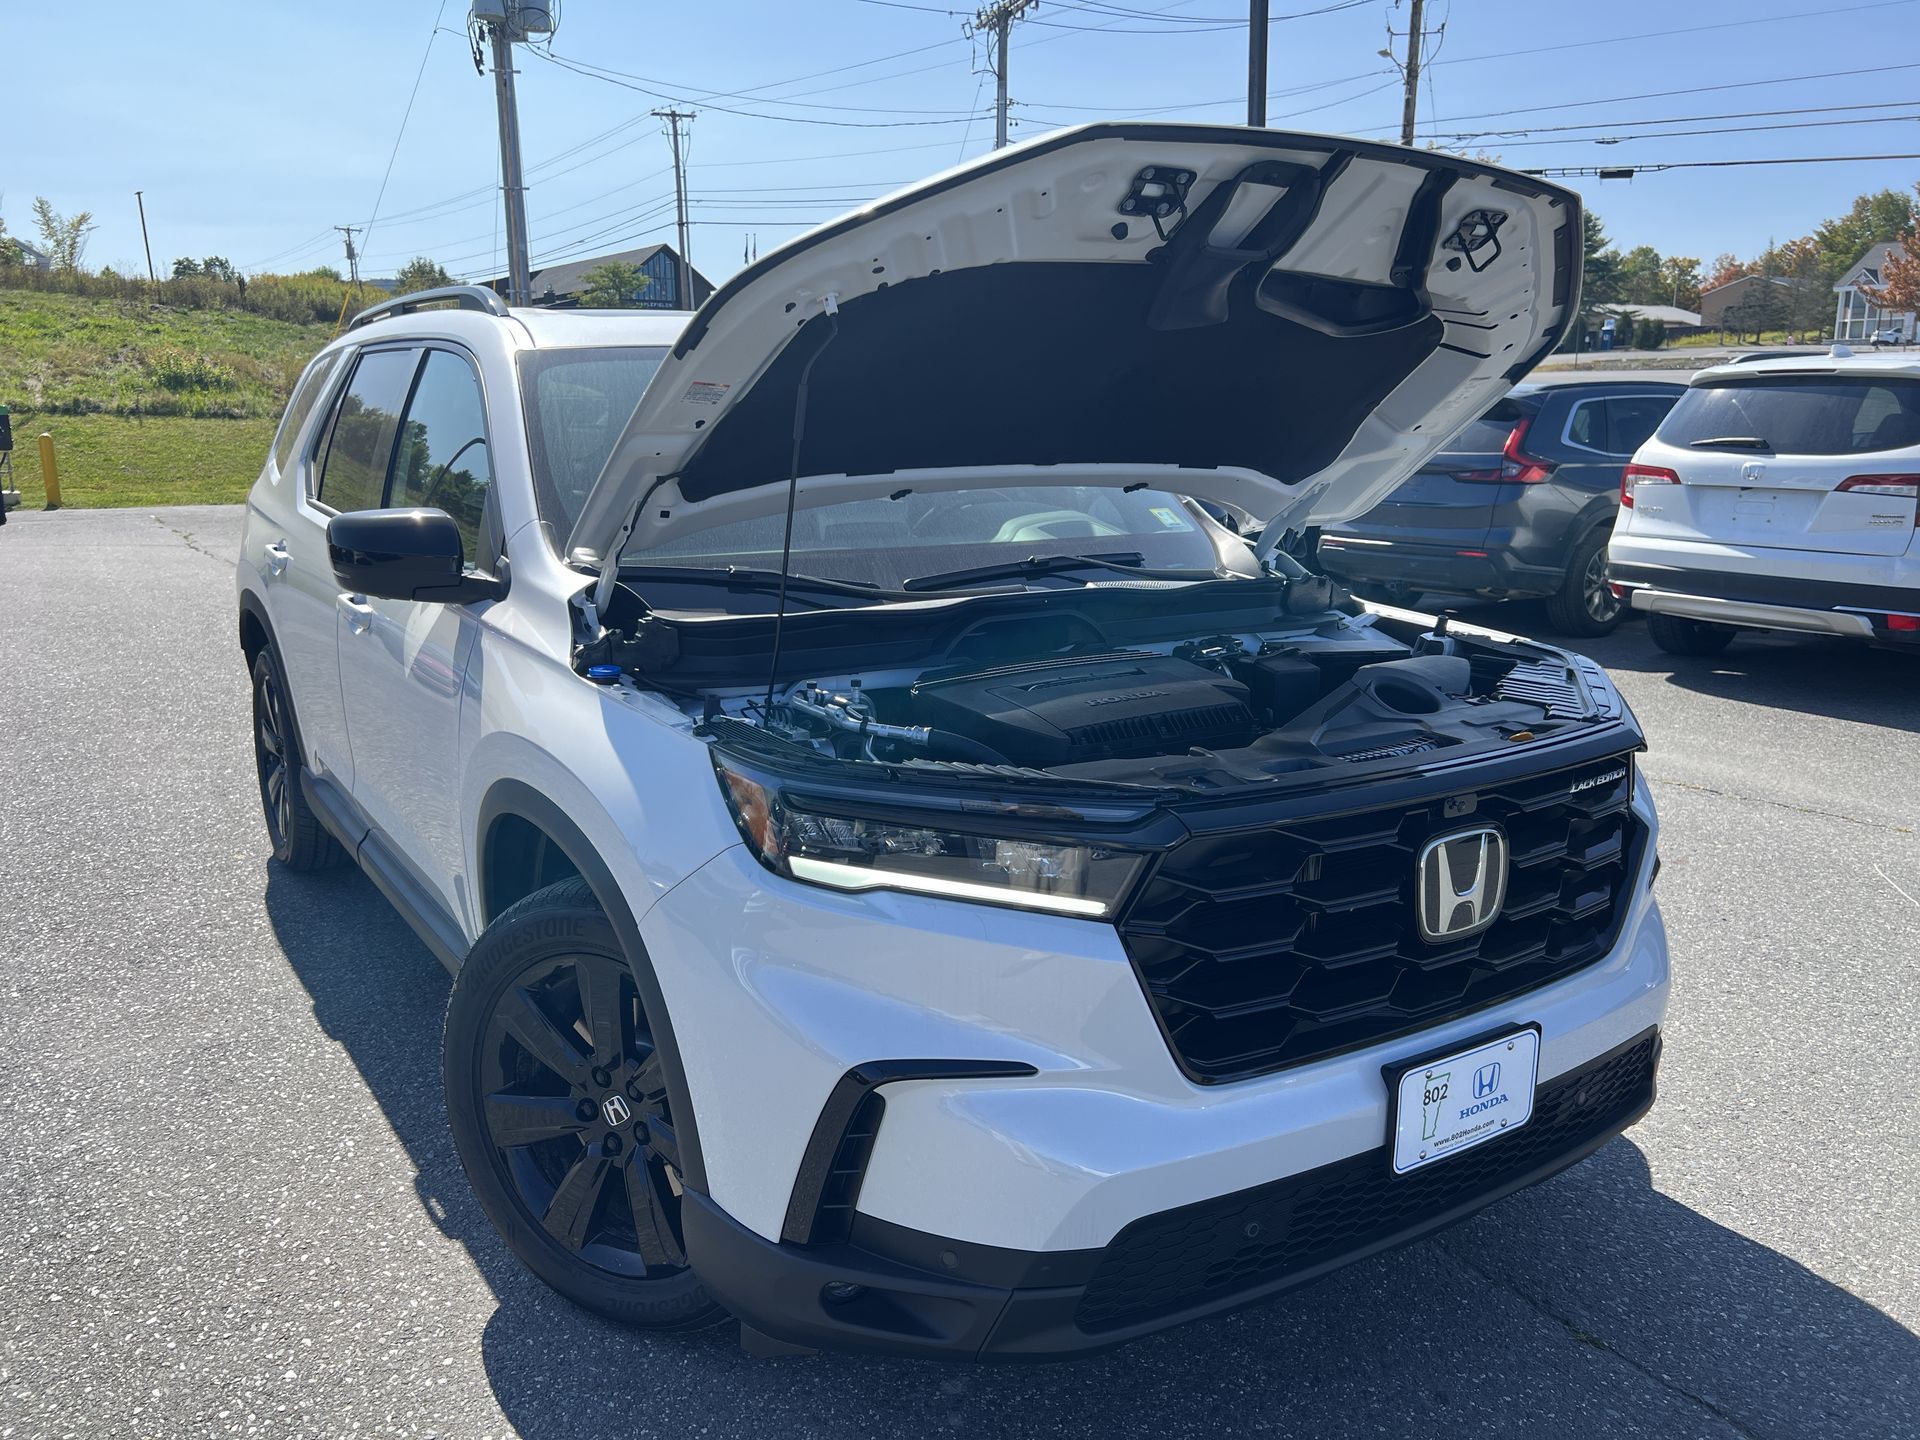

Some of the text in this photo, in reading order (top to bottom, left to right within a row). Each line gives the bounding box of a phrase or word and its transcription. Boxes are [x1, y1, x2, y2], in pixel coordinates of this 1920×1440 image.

[1085, 690, 1170, 706] HONDA
[1596, 767, 1626, 785] EDITION
[466, 917, 586, 993] BRIDGESTONE
[1423, 1083, 1449, 1106] 802
[1459, 1094, 1509, 1119] HONDA
[1434, 1120, 1494, 1147] www.802Honda.com
